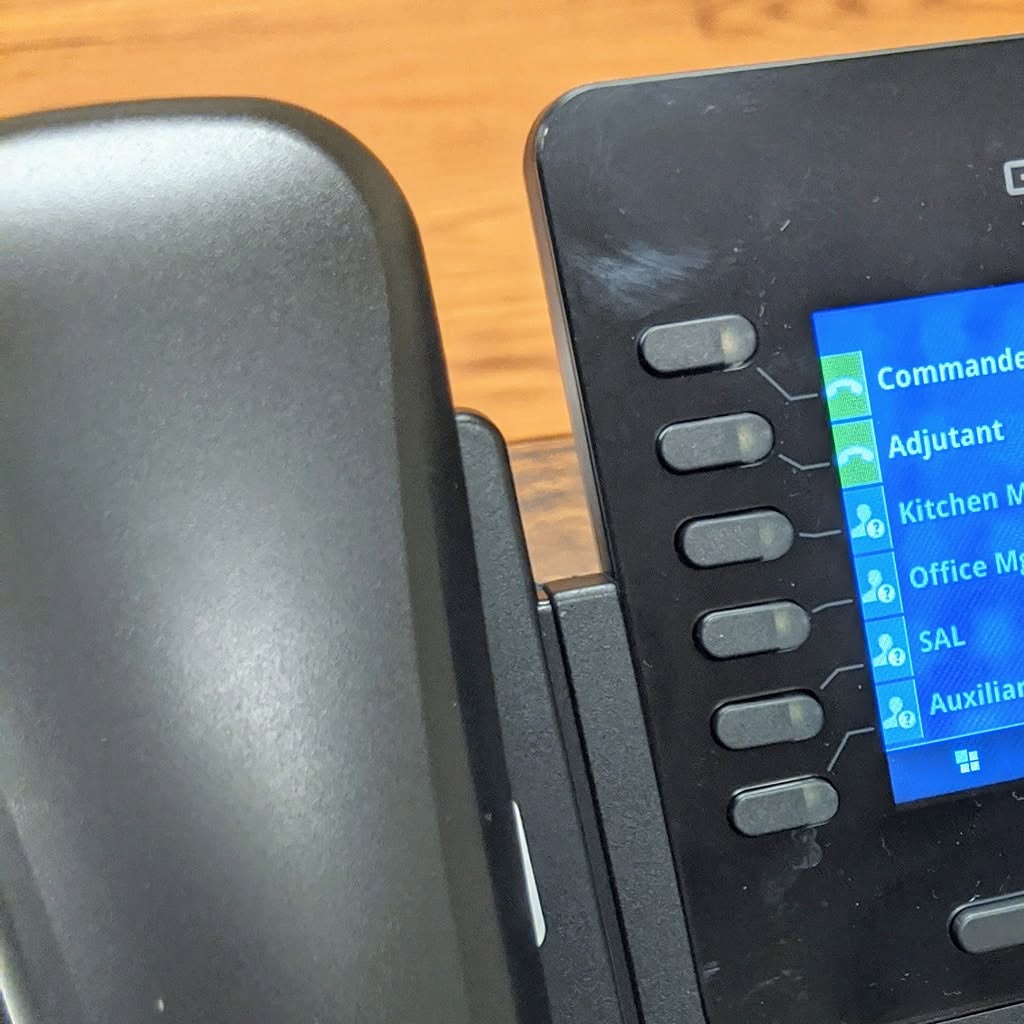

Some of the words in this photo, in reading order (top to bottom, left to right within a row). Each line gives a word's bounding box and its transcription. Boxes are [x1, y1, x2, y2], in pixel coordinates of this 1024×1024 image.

[888, 419, 1005, 460] Adjutant
[898, 490, 999, 525] Kitchen
[909, 559, 988, 589] Office
[919, 625, 966, 653] SAL
